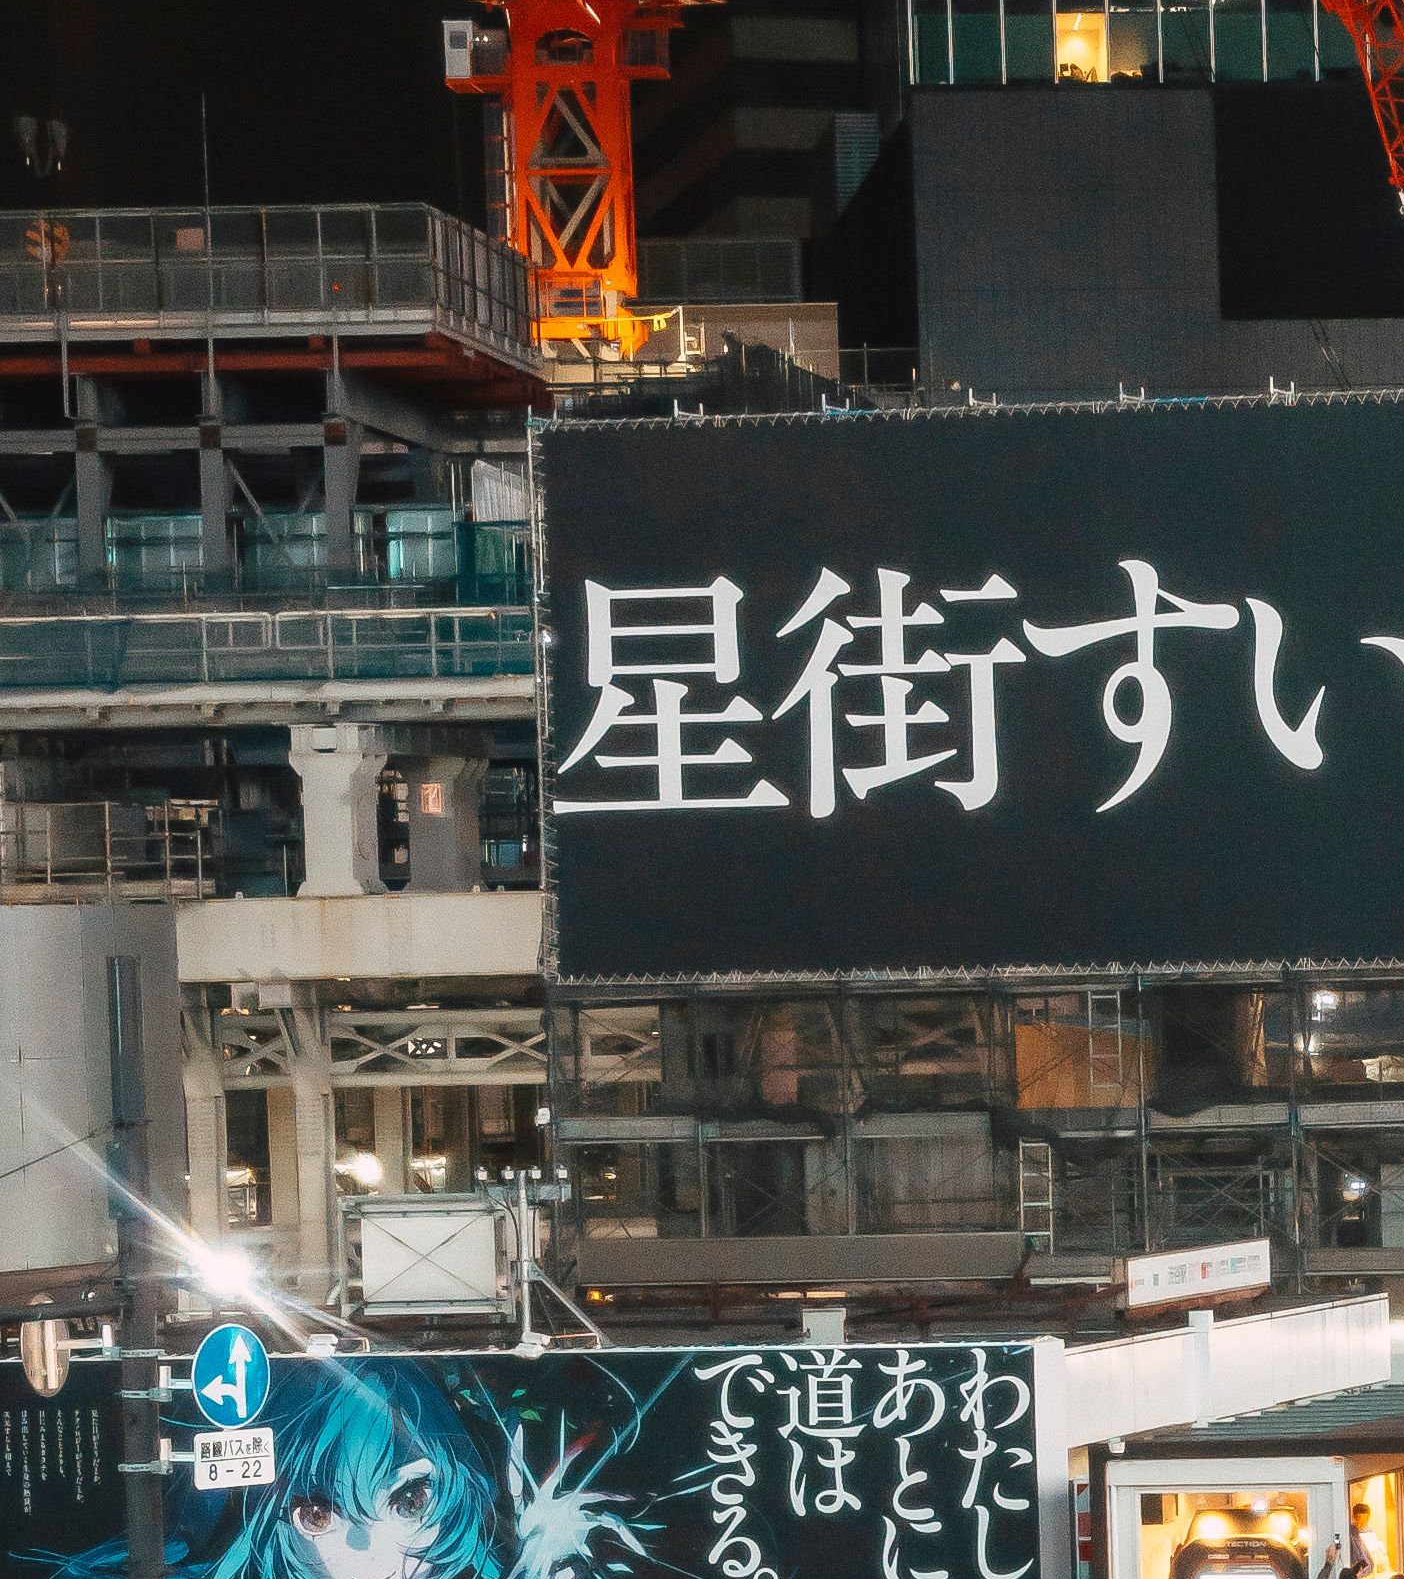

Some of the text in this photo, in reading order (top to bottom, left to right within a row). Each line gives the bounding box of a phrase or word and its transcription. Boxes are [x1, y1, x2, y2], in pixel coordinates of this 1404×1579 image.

[201, 1437, 269, 1459] 路線バスを除く
[777, 1349, 868, 1517] 道は
